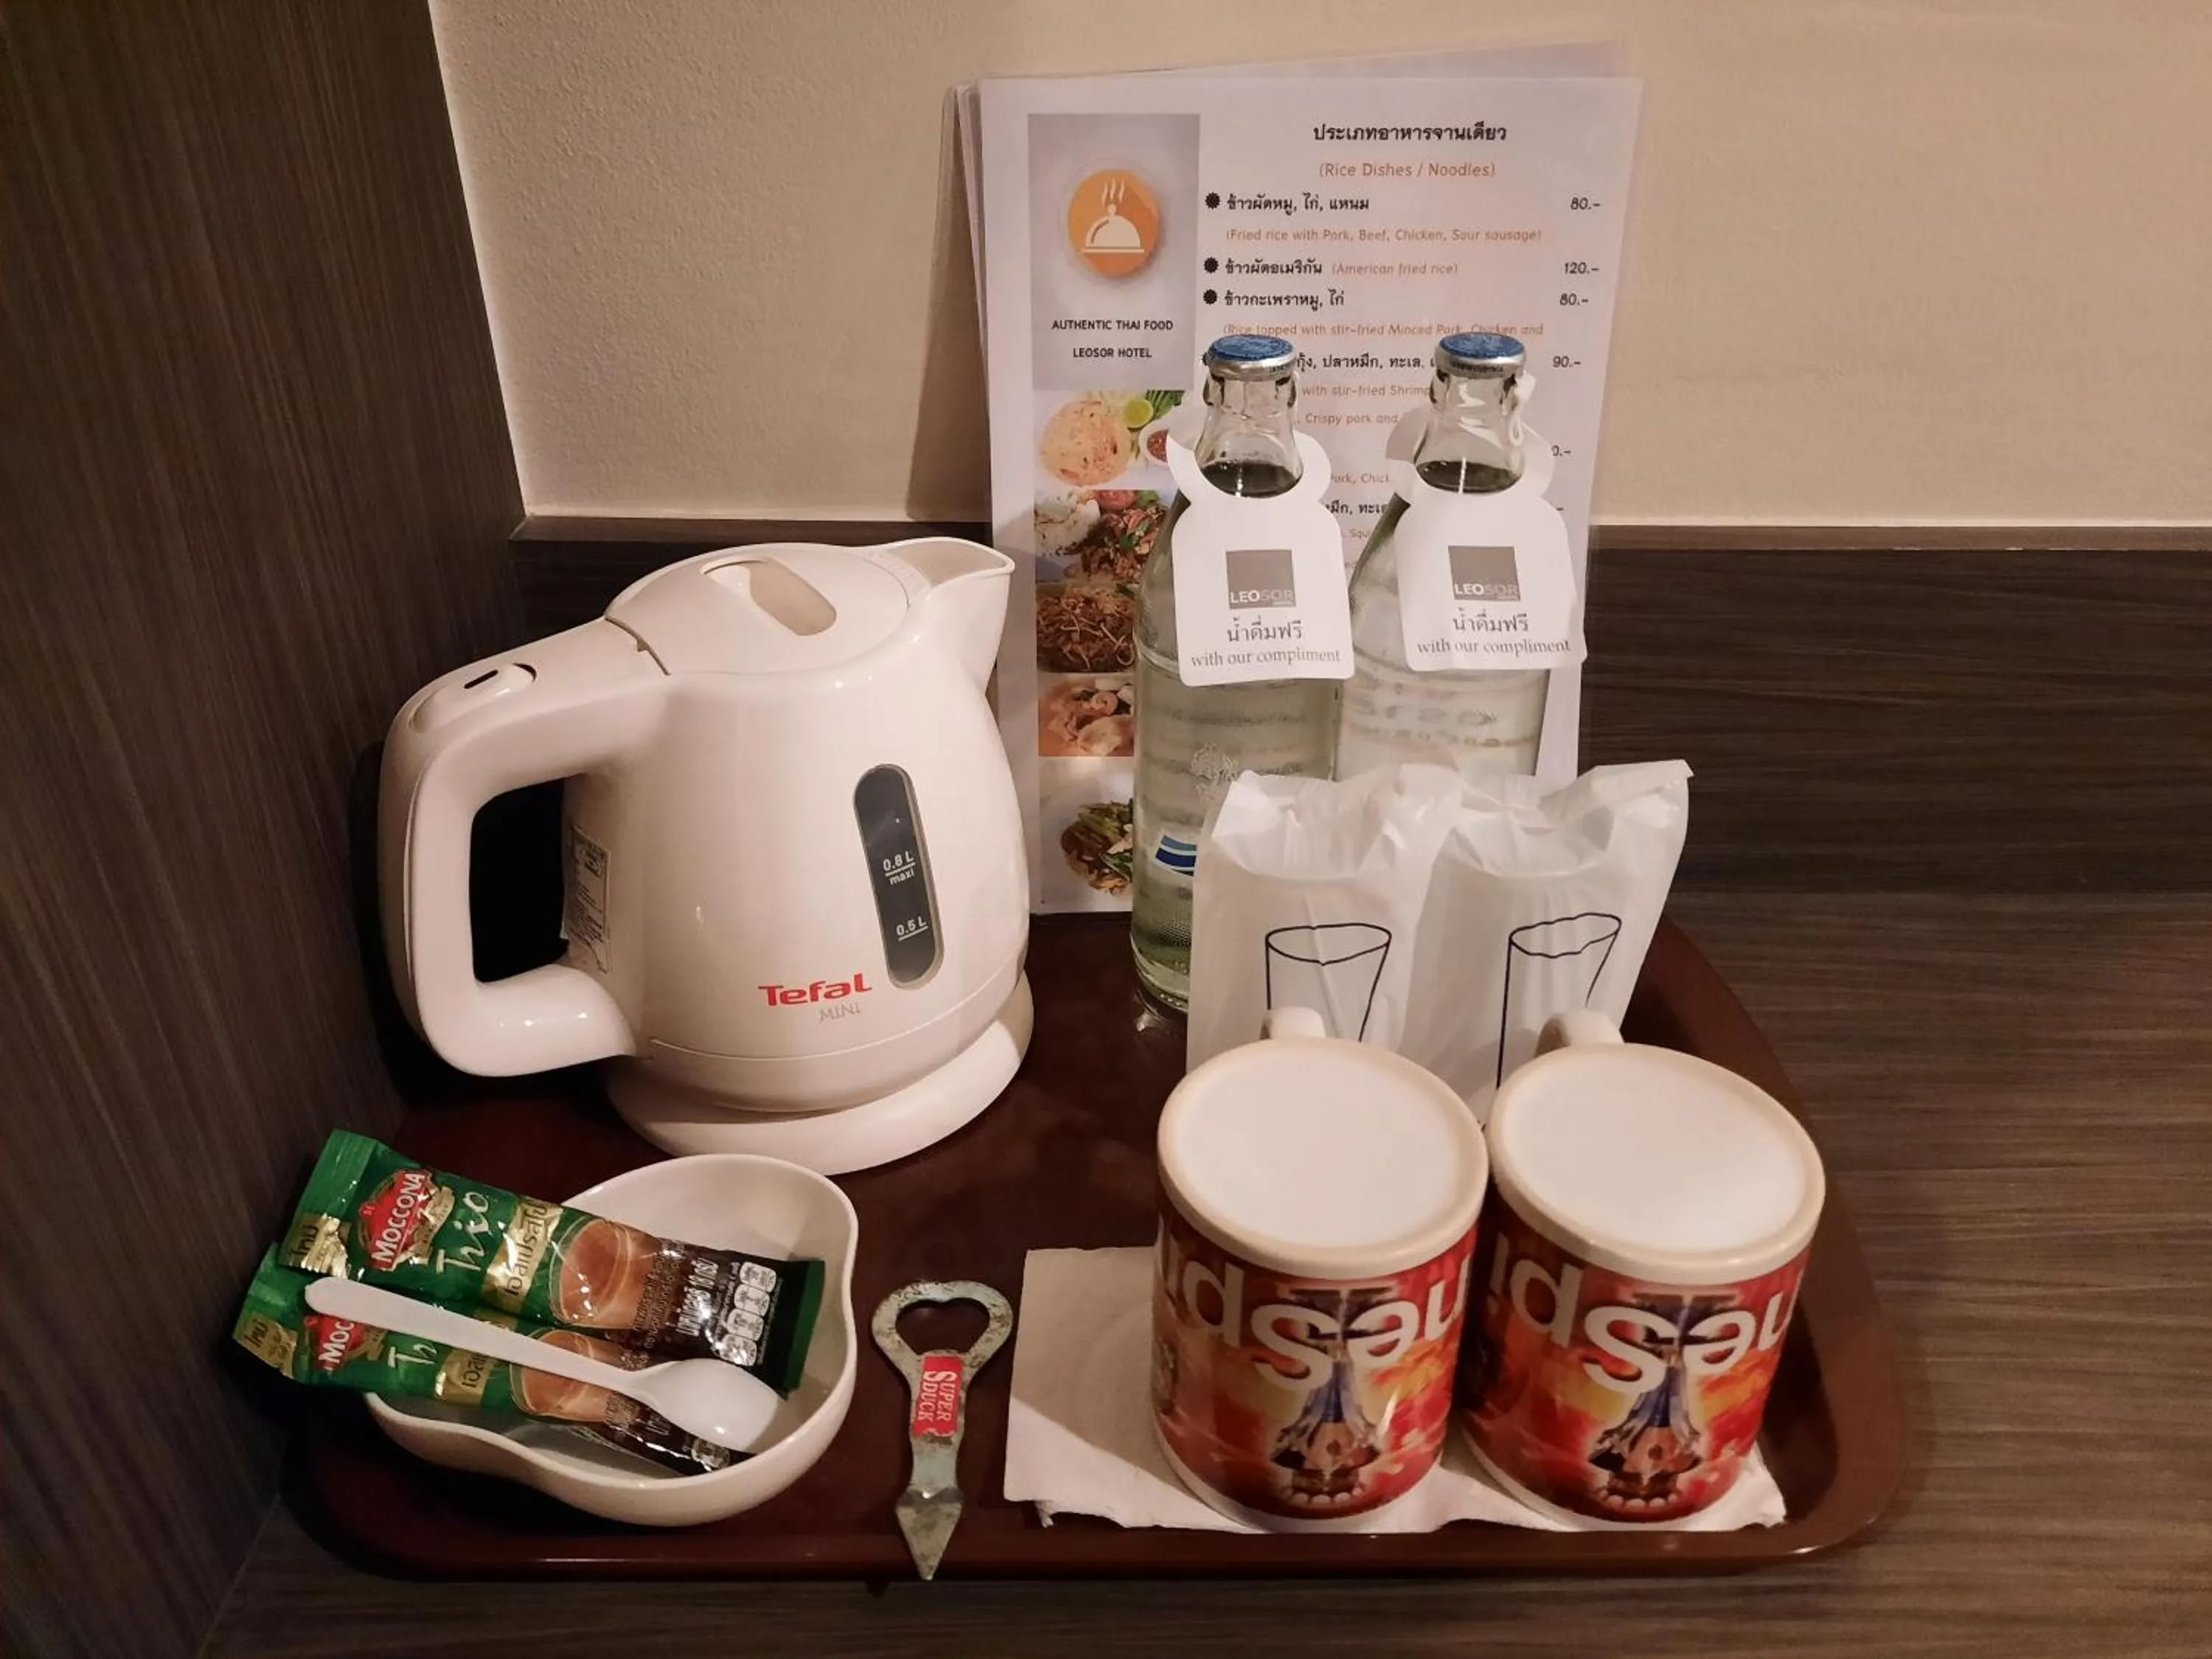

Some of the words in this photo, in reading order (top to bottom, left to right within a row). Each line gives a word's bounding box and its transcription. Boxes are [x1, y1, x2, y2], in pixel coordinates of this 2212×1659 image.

[1313, 120, 1507, 141] ประเภทอาหารจานเดียว
[1319, 162, 1356, 178] (Rice
[1363, 162, 1412, 177] Dishes
[1428, 162, 1496, 177] Noodles)
[1570, 197, 1601, 210] 80.-
[1266, 229, 1288, 241] rice
[1293, 229, 1318, 241] with
[1324, 229, 1354, 242] Pork,
[1396, 229, 1447, 242] Chicken,
[1452, 229, 1481, 241] Sour
[1332, 263, 1394, 275] (American
[1399, 263, 1427, 275] fried
[1564, 262, 1599, 274] 120.-
[1559, 293, 1589, 306] 80.-
[1051, 319, 1112, 330] AUTHENTIC
[1116, 320, 1141, 330] THAI
[1144, 320, 1174, 330] FOOD
[1301, 323, 1326, 335] with
[1388, 324, 1433, 335] Minced
[1521, 324, 1544, 335] and
[1073, 347, 1114, 358] LEOSOR
[1118, 348, 1152, 358] HOTEL
[1552, 356, 1582, 368] 90.-
[1302, 384, 1327, 397] with
[1305, 412, 1343, 425] Crispy
[1346, 413, 1371, 425] pork
[1376, 414, 1399, 424] and
[1230, 589, 1295, 604] LEOSOR
[1453, 607, 1529, 632] น้ำดื่มฟรี
[1227, 615, 1304, 642] น้ำดื่มฟรี
[1417, 638, 1450, 653] with
[1454, 641, 1479, 652] our
[1483, 638, 1571, 657] compliment
[1192, 651, 1223, 667] with
[1227, 654, 1253, 665] our
[1256, 647, 1340, 666] compliment
[883, 854, 904, 871] 0.8
[905, 850, 915, 863] L
[889, 869, 915, 886] maxi
[917, 915, 927, 927] L
[373, 1172, 425, 1264] MOCCONA
[436, 1191, 493, 1274] Trio
[918, 1380, 939, 1422] DUCK
[931, 1371, 958, 1422] SUPER
